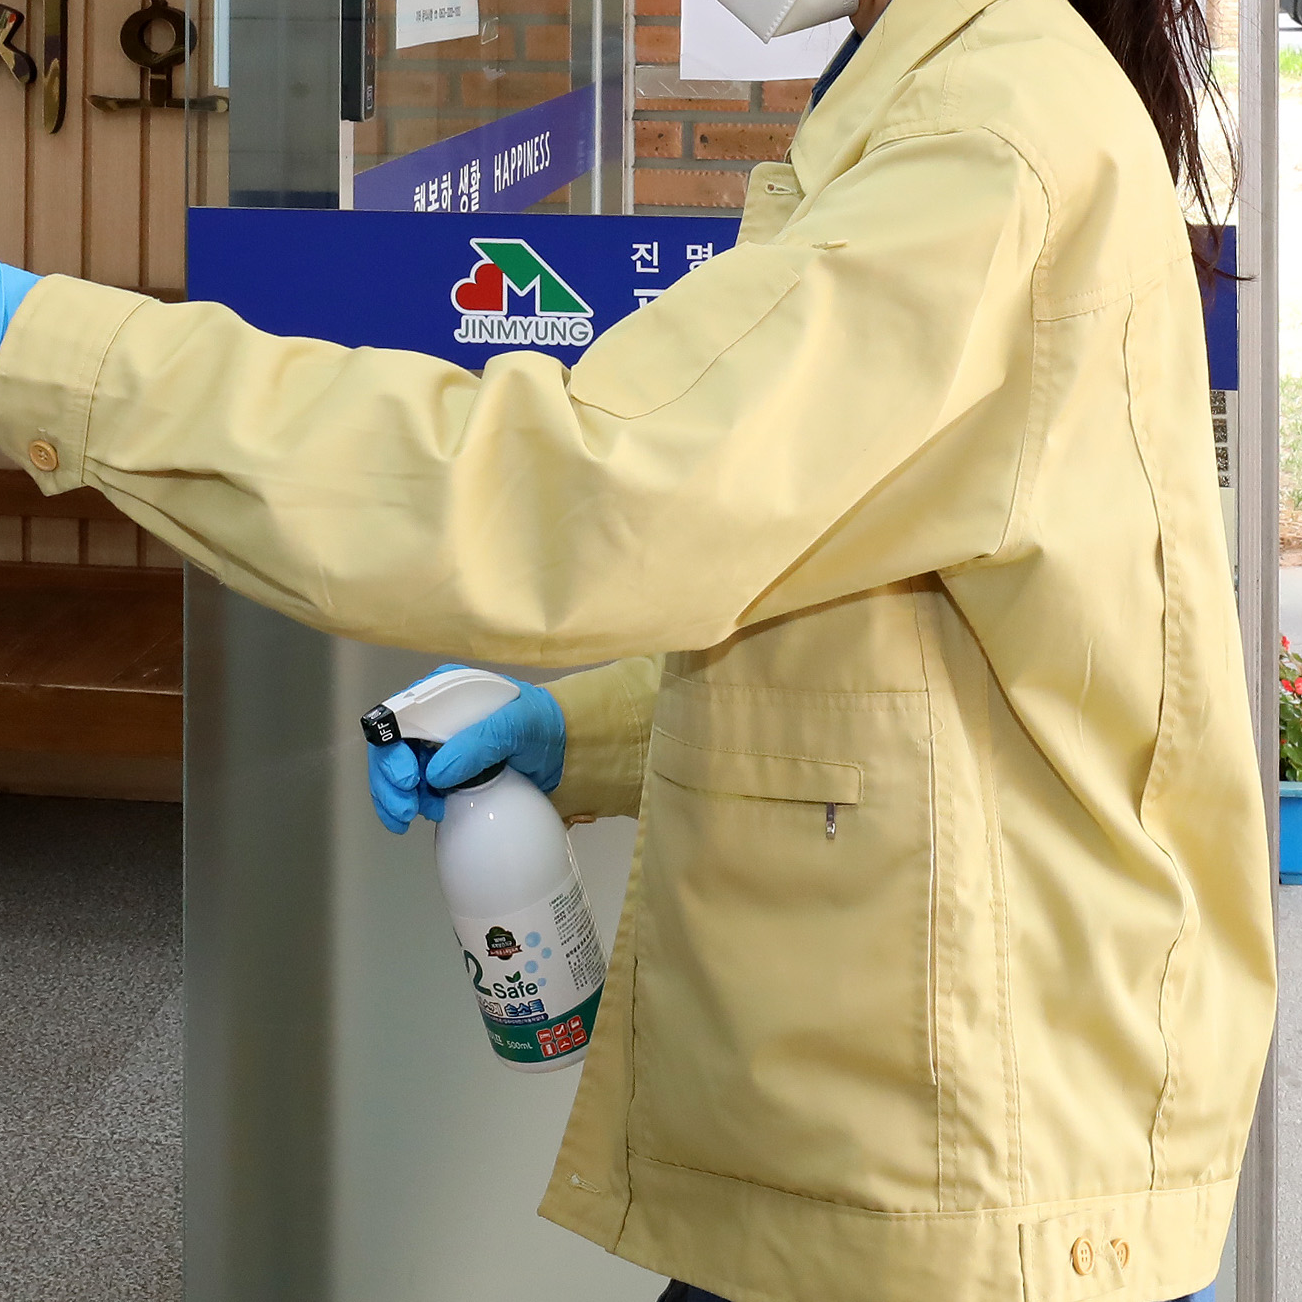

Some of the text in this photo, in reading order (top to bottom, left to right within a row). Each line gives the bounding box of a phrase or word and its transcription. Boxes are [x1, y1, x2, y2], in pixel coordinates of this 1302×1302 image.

[458, 158, 481, 213] 생활
[494, 131, 551, 194] HAPPINESS
[458, 318, 590, 342] JINMYUNG
[377, 722, 394, 742] OFF
[492, 981, 539, 1000] Safe
